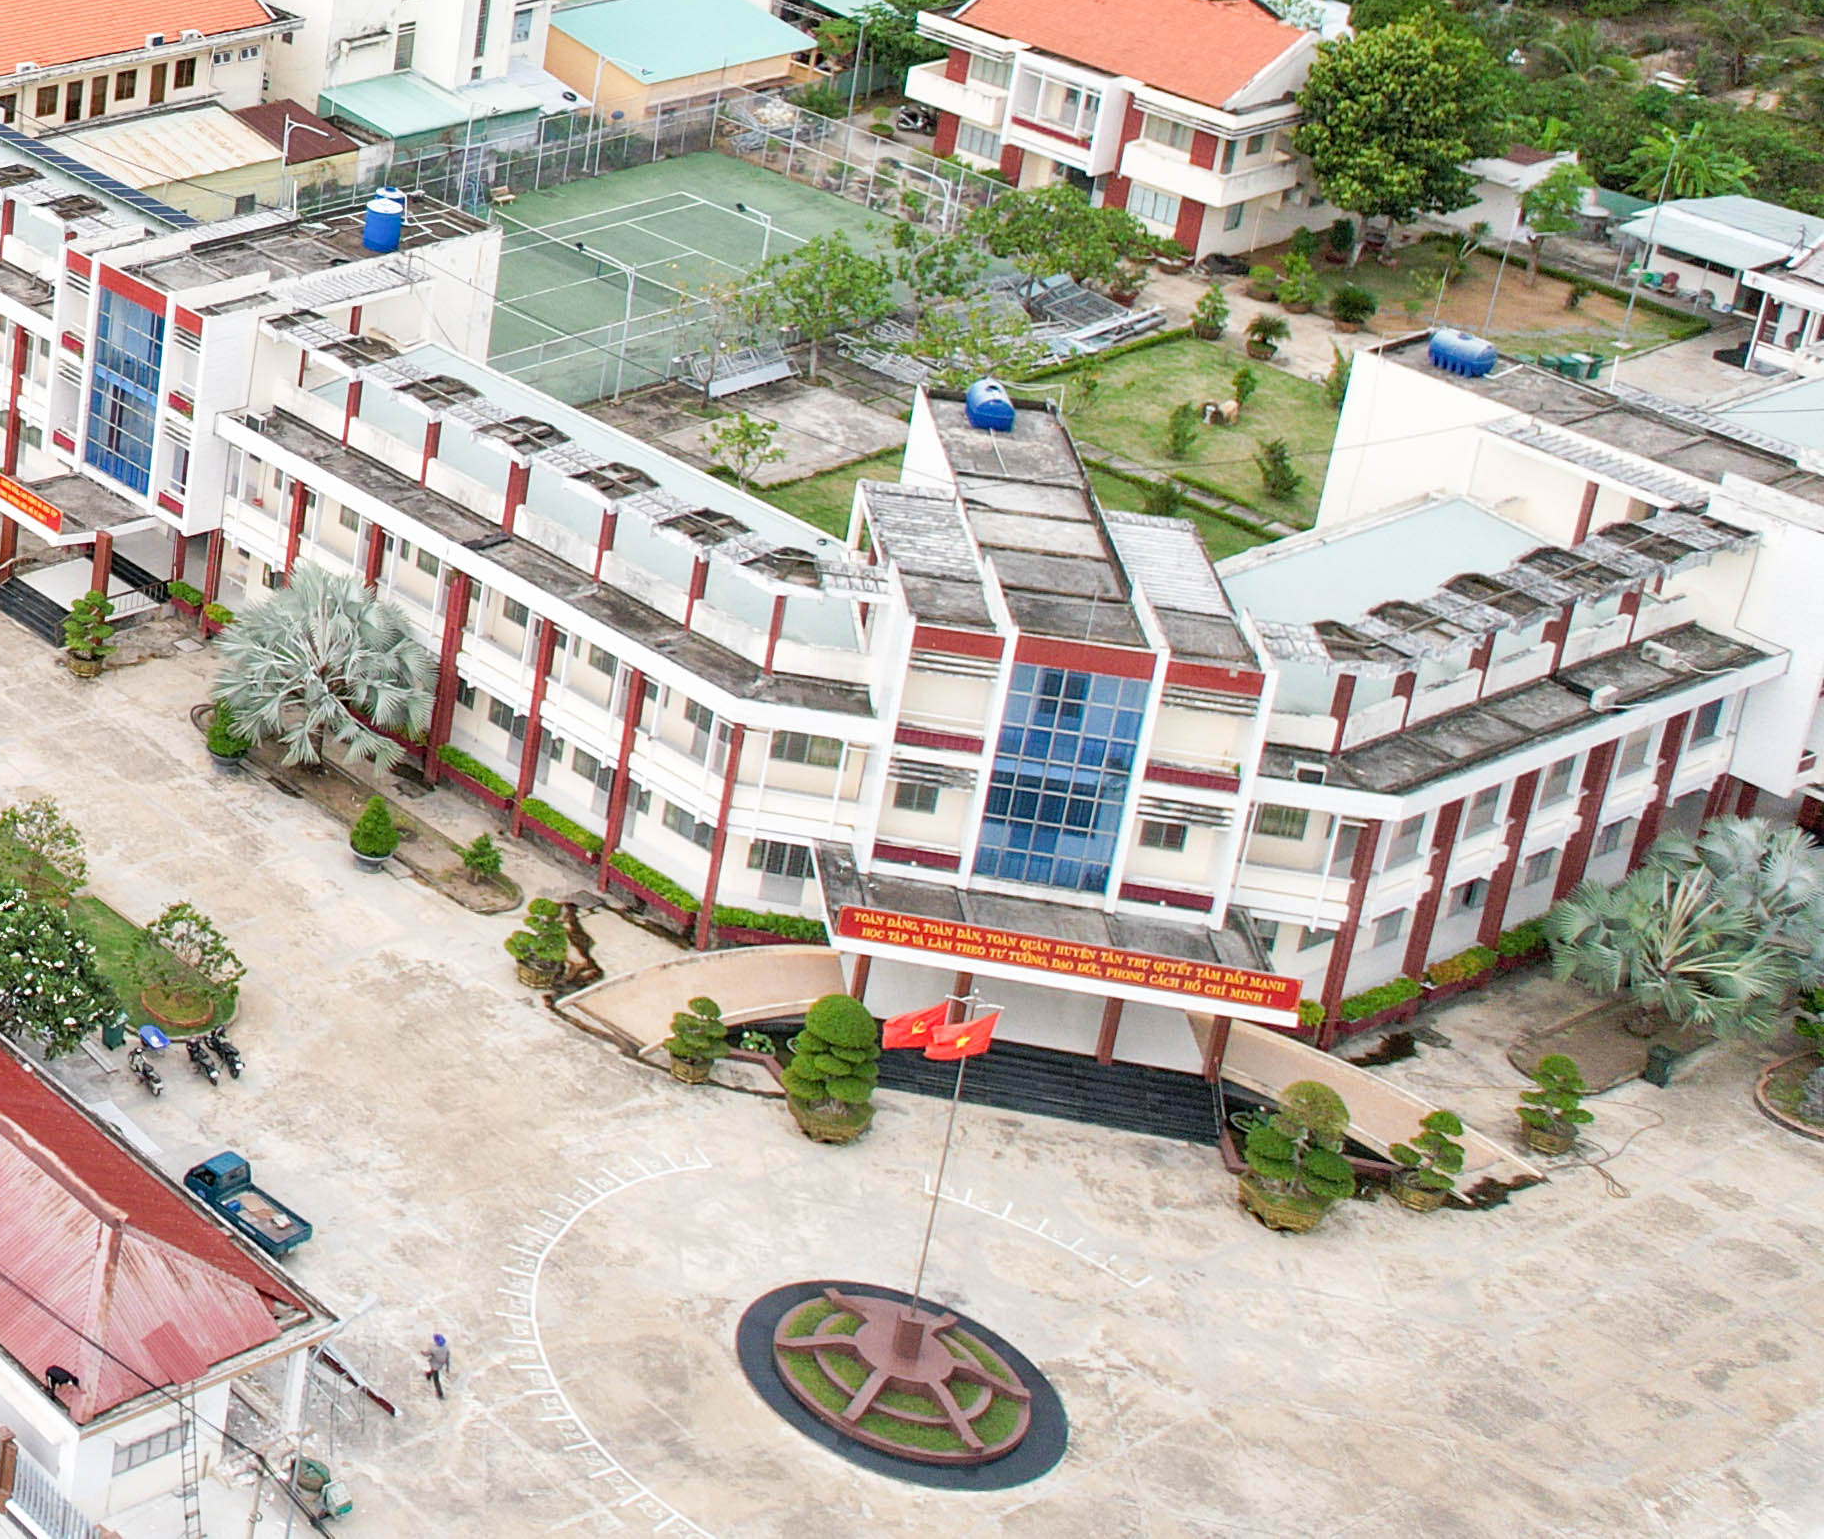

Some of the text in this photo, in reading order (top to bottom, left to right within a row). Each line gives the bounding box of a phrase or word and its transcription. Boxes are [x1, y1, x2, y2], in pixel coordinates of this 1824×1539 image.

[854, 912, 1287, 993] TOÀN ĐẢNG, TOÀN DÂN, TOÀN QUÂN HUYỆN TÂN TRỤ QUYẾT TÂM ĐẨY MẠNH
[861, 928, 885, 941] HỌC
[887, 930, 910, 944] TẬP
[912, 933, 925, 947] VÀ
[927, 936, 953, 952] LÀM
[955, 941, 986, 956] THEO
[989, 947, 1008, 959] TƯ
[1051, 958, 1074, 972] ĐẠO
[1077, 960, 1103, 977] ĐỨC,
[1106, 967, 1145, 983] PHONG
[1149, 973, 1181, 989] CÁCH
[1183, 978, 1203, 992] HỒ
[1204, 981, 1227, 996] CHÍ
[1230, 987, 1263, 1003] MINH
